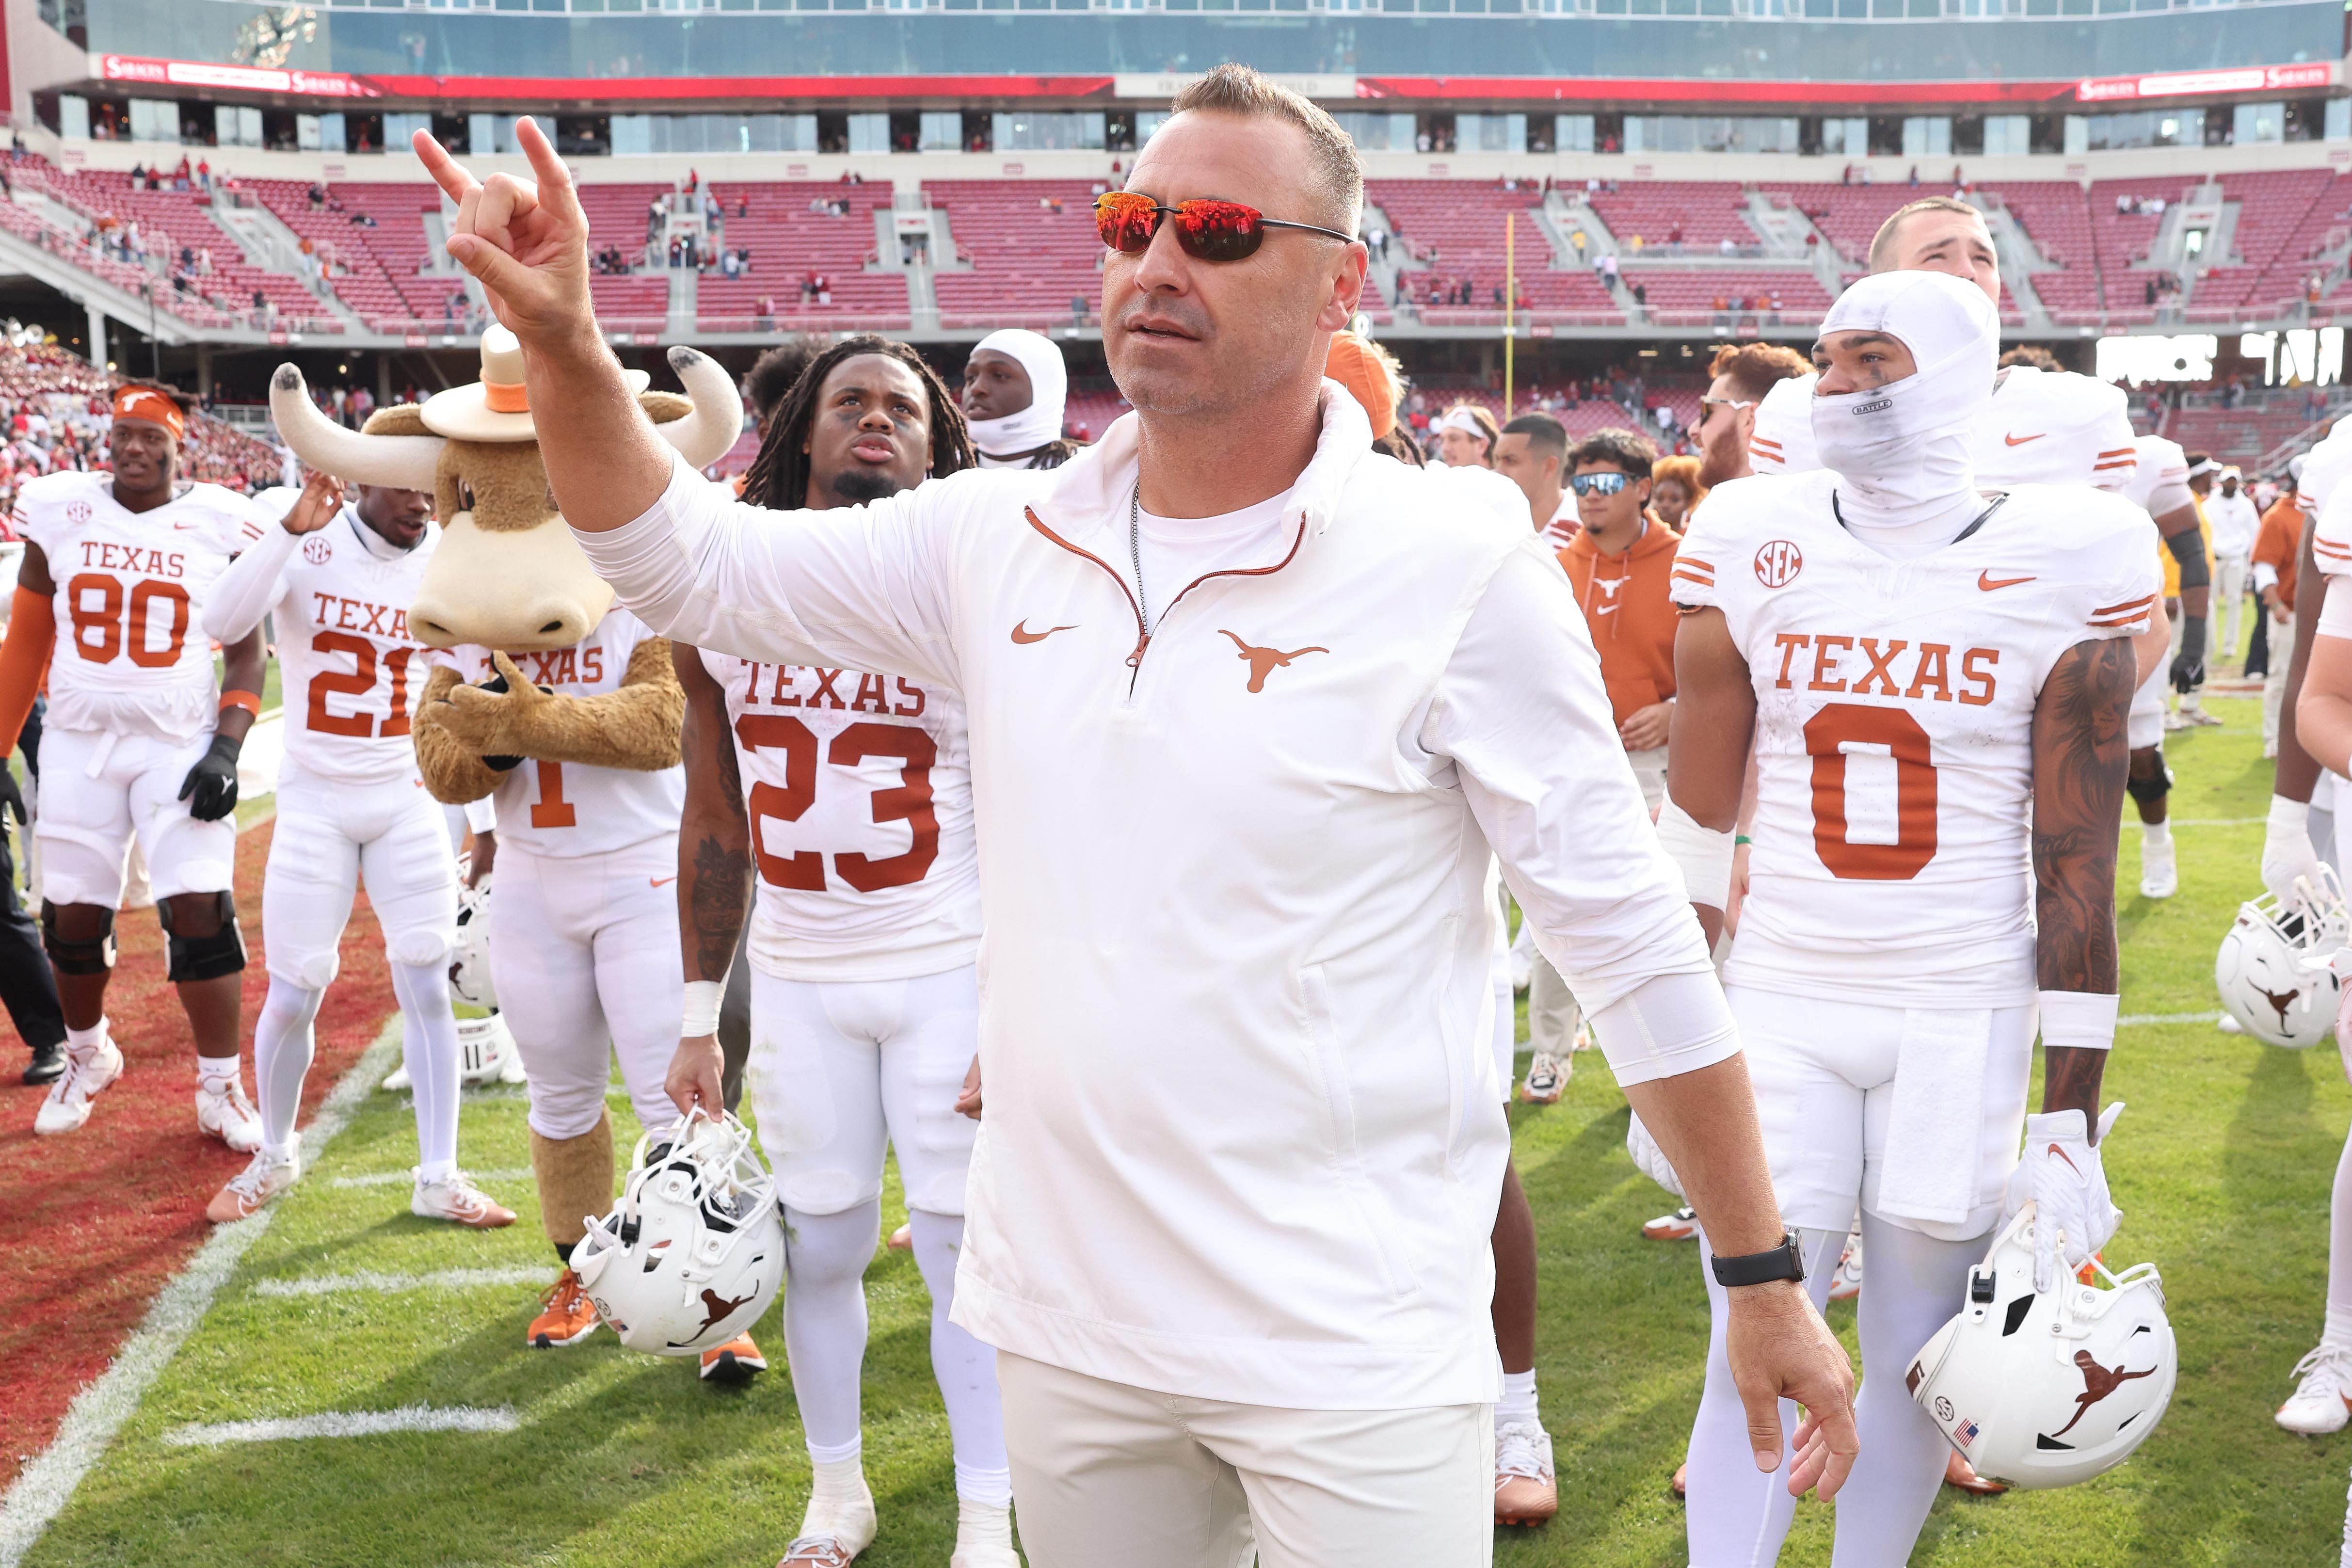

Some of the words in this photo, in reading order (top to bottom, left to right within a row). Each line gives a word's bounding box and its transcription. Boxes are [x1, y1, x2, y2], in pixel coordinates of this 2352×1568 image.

[1856, 401, 1889, 413] BATTLE
[80, 541, 184, 577] TEXAS
[304, 536, 332, 565] SEC
[1754, 540, 1803, 588] SEC
[69, 574, 190, 668] 80
[314, 592, 410, 640] TEXA
[307, 630, 416, 737] 21
[742, 659, 925, 717] TEXAS
[1776, 633, 1999, 706] TEXAS
[735, 714, 940, 893] 23
[1803, 703, 1937, 880] 0
